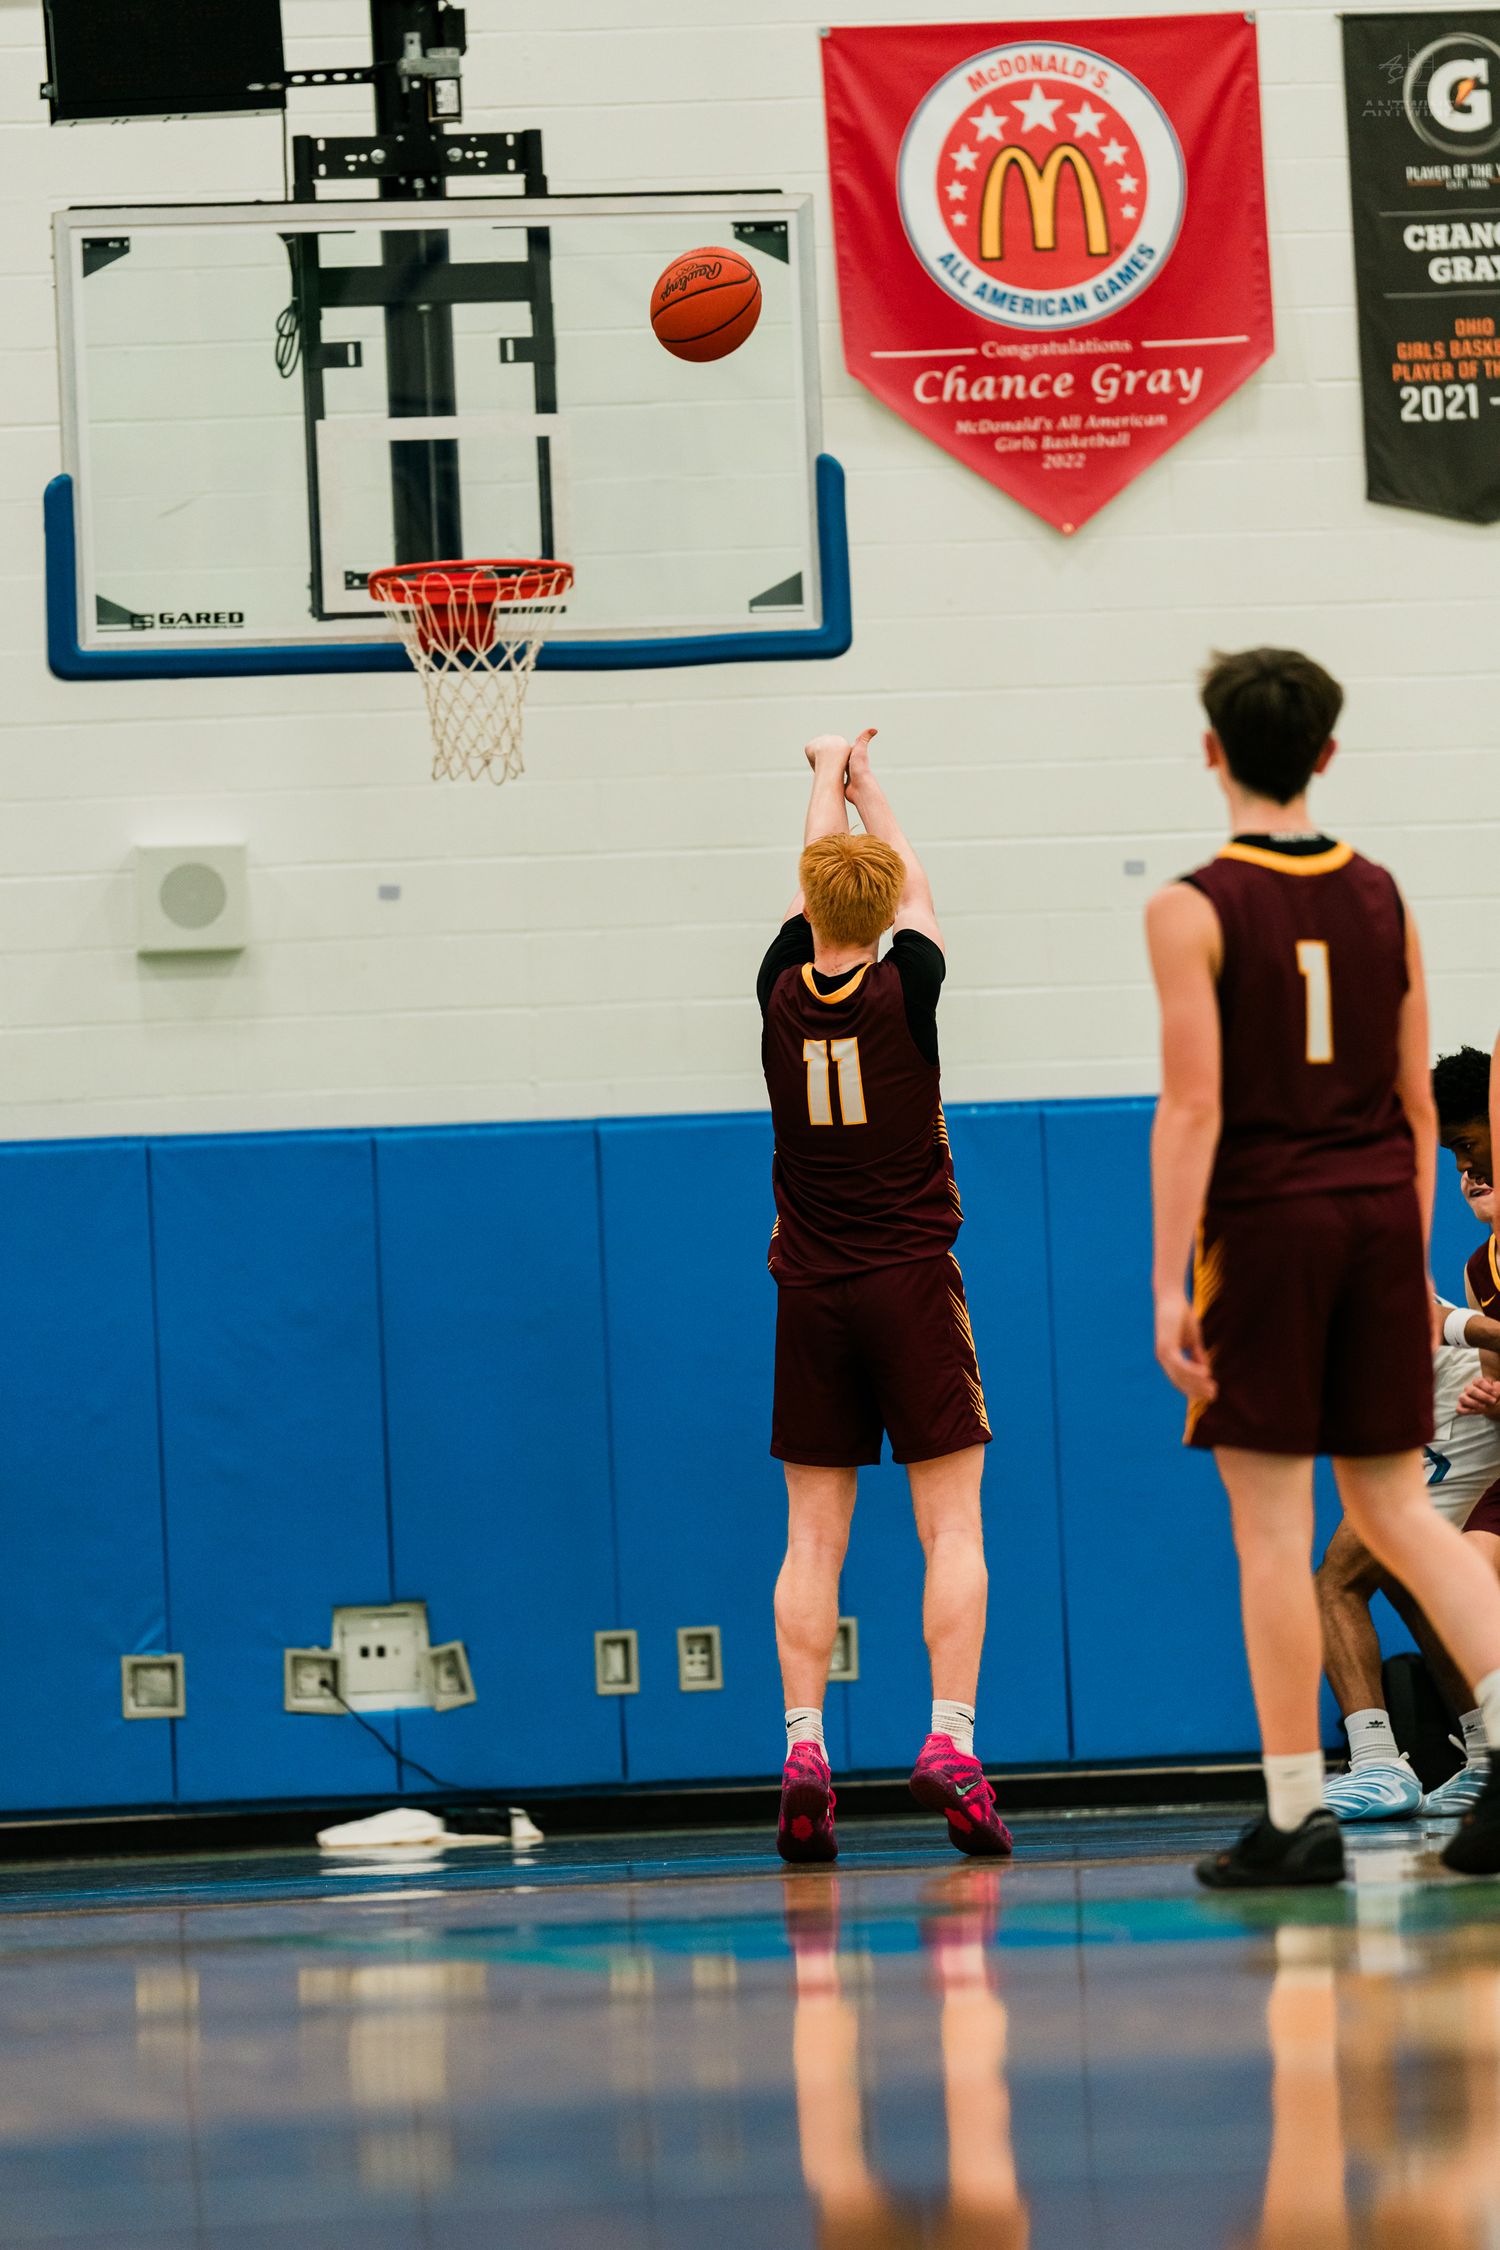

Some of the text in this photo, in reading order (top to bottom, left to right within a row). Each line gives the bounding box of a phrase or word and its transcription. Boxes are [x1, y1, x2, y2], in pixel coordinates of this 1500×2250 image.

[967, 54, 1108, 92] McDONALD'S
[1427, 58, 1492, 132] G
[1405, 165, 1452, 180] PLAYER
[1471, 162, 1493, 179] THE
[661, 261, 722, 302] Rawlings
[938, 243, 1154, 316] ALL AMERICAN GAMES
[1455, 316, 1495, 337] OHIO
[980, 338, 1133, 361] Congratulations
[1397, 341, 1446, 361] GIRLS
[1392, 361, 1455, 382] PLAYER
[1458, 360, 1478, 380] OF
[913, 363, 1203, 404] Chance Gray
[1400, 383, 1480, 423] 2021
[954, 412, 1168, 435] McDonald's All American
[994, 431, 1131, 453] Girls Basketball
[1042, 452, 1087, 470] 2022
[159, 611, 245, 625] GARED
[1296, 939, 1333, 1064] 1
[803, 1036, 868, 1126] 11
